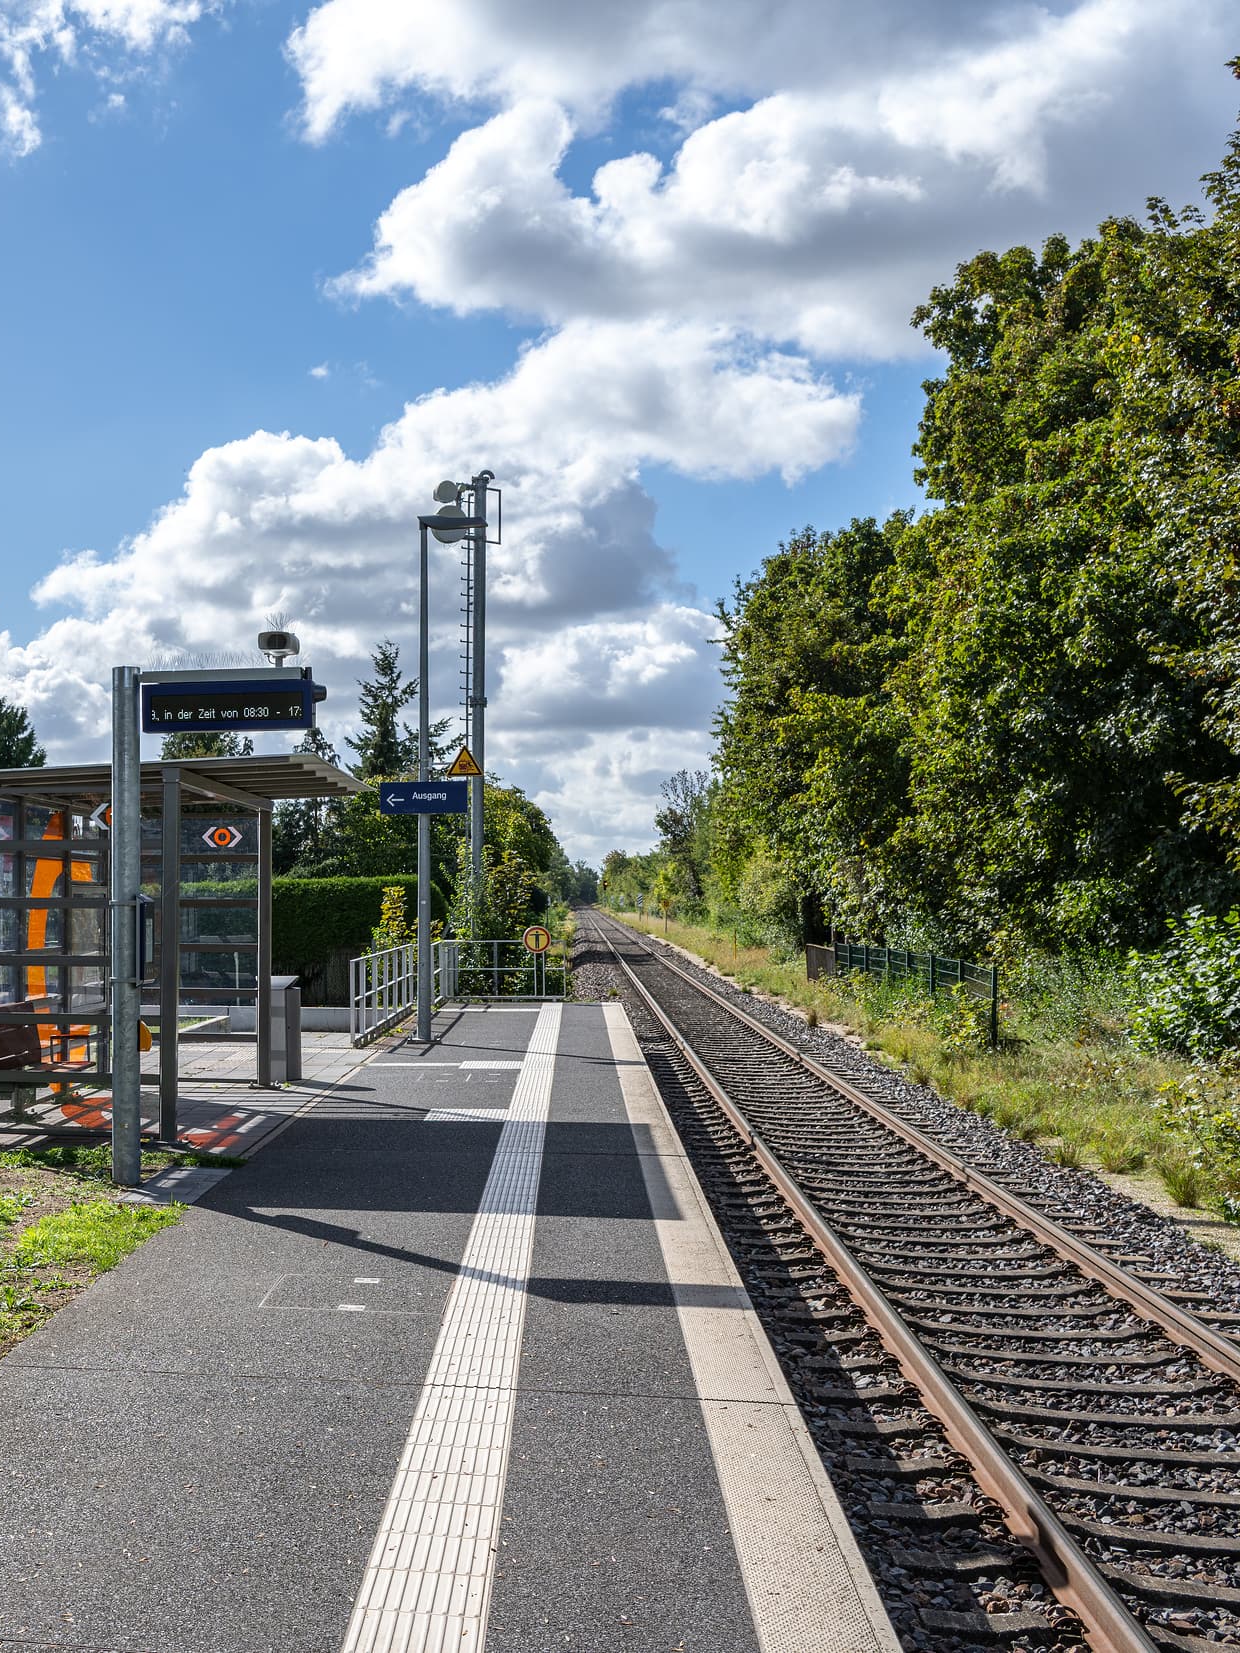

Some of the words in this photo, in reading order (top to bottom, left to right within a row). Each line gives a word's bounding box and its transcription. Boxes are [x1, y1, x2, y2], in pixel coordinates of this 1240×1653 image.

[164, 709, 173, 720] in
[177, 708, 193, 720] der
[198, 708, 216, 719] Zeit
[221, 710, 239, 718] von
[243, 706, 269, 718] 08:30
[412, 791, 447, 801] Ausgang
